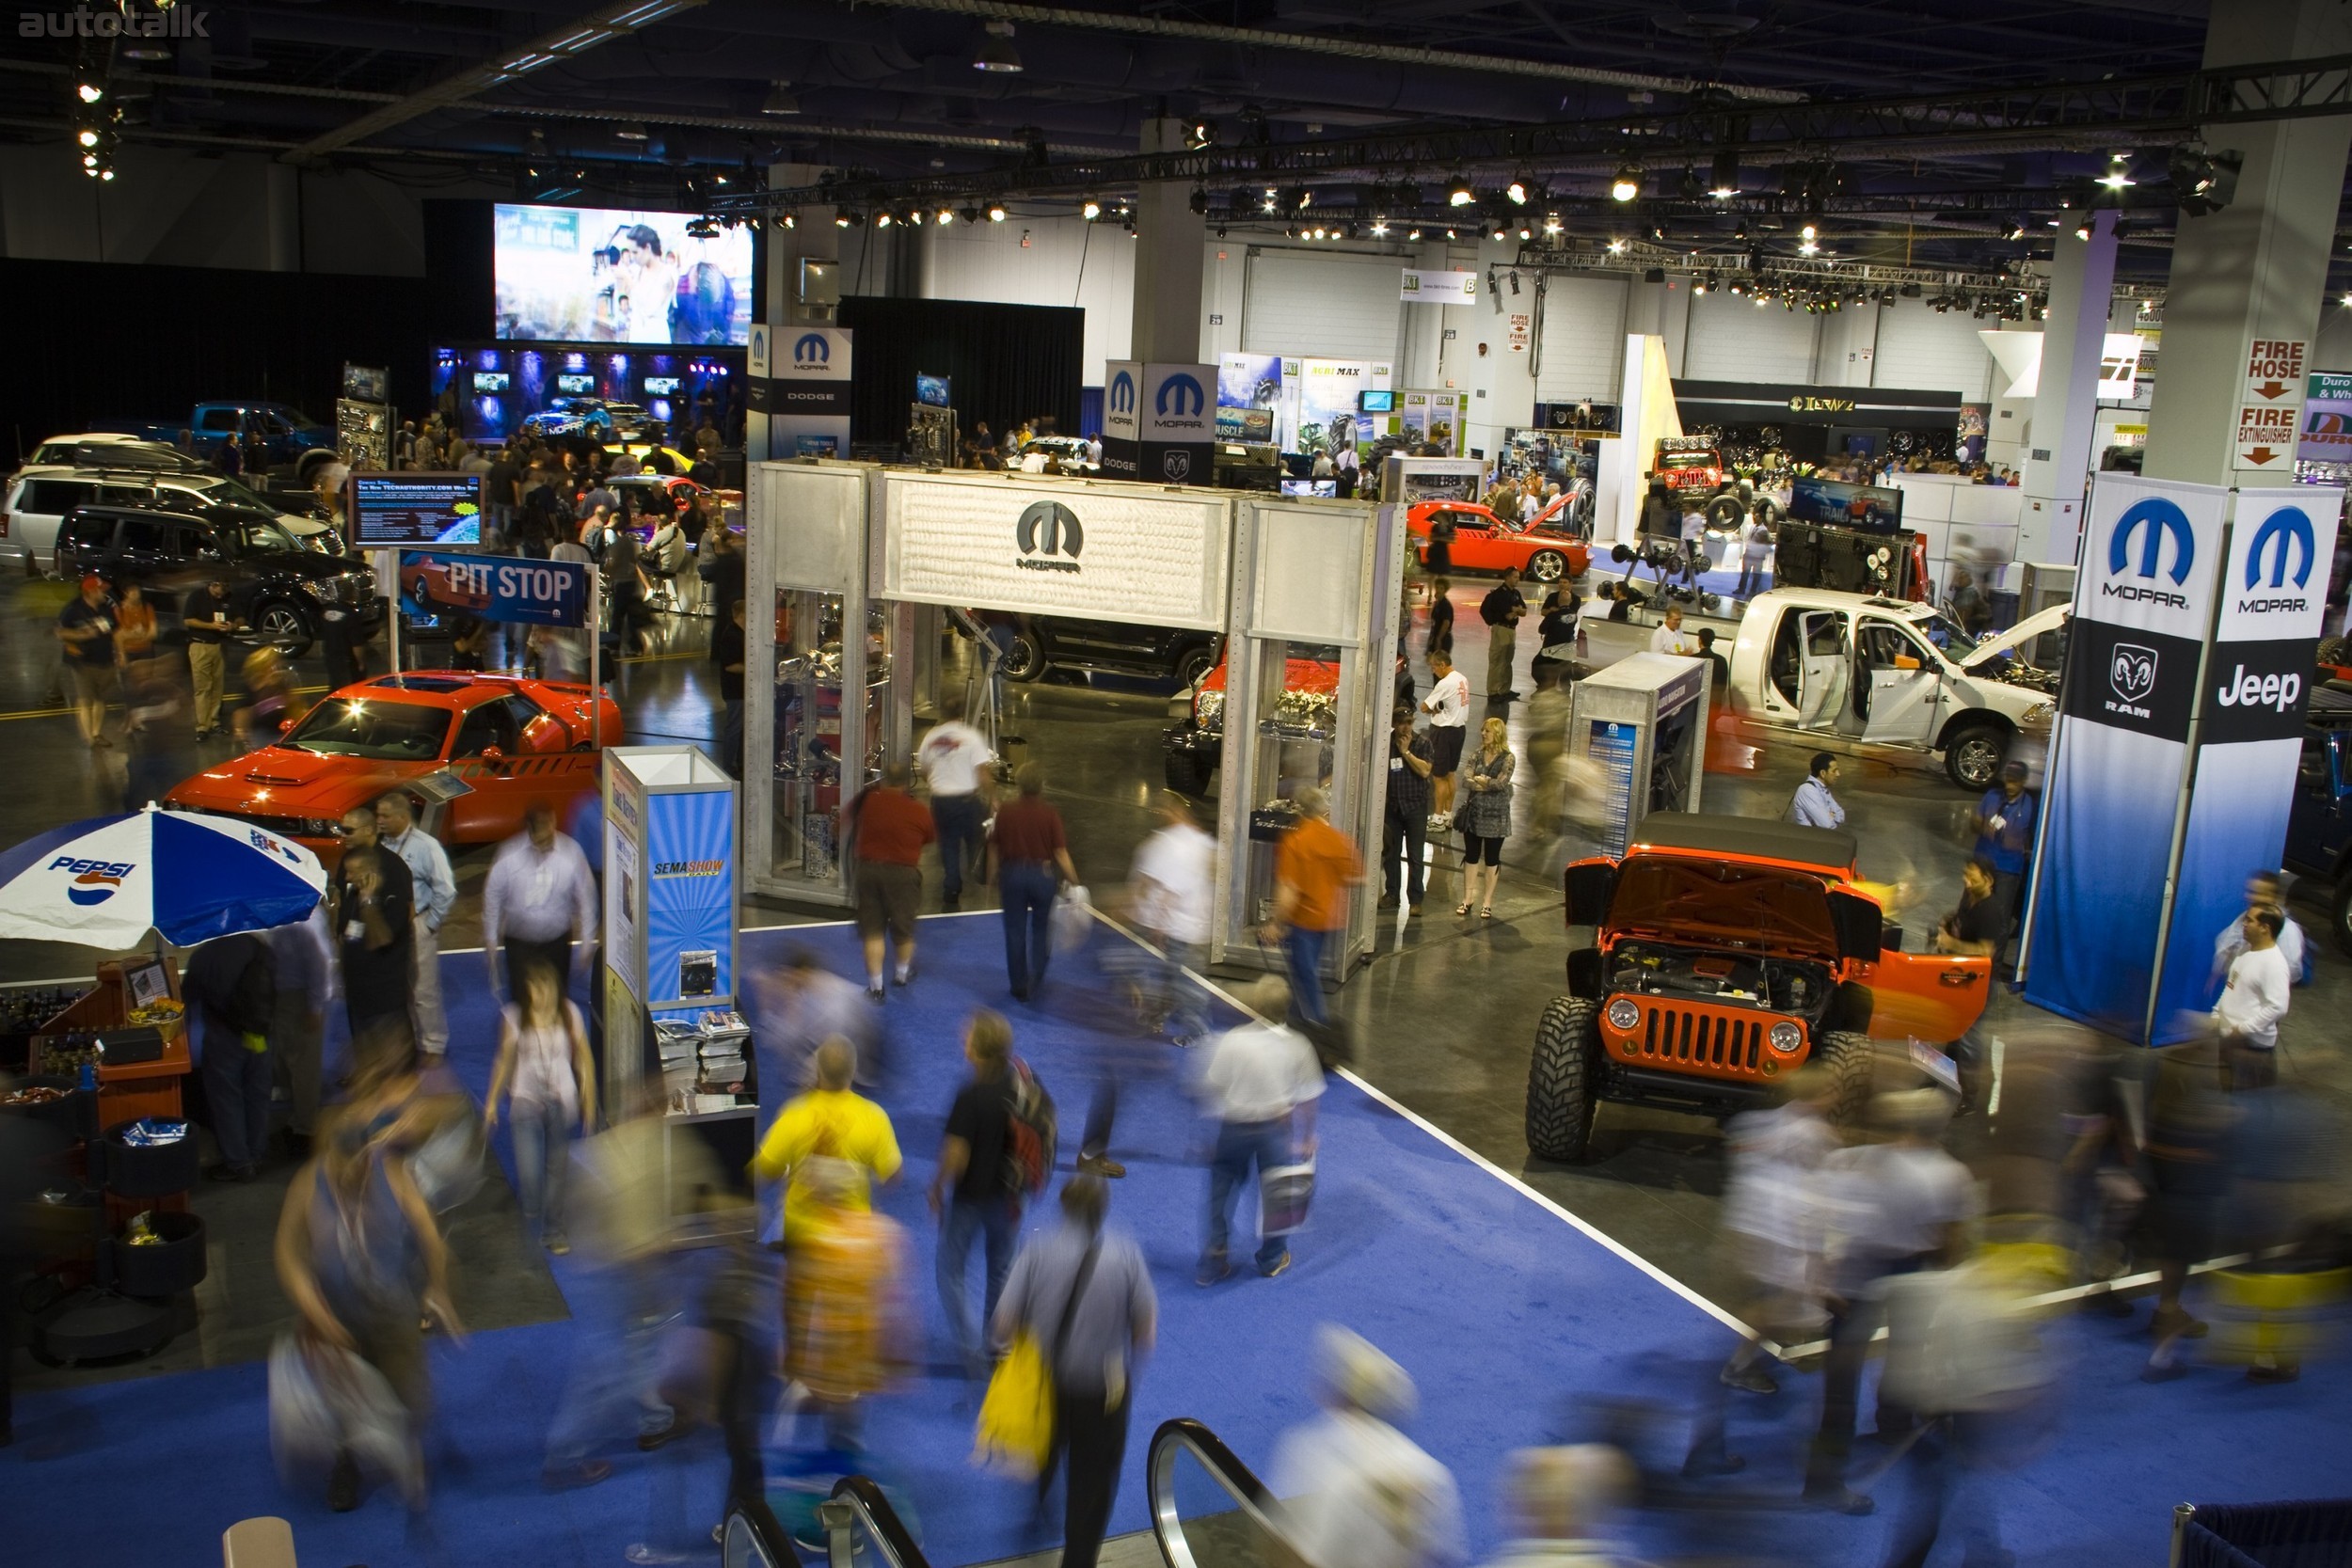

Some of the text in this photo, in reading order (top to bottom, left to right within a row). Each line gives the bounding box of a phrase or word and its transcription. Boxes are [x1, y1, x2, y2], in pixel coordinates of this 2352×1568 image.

[2250, 341, 2305, 359] FIRE
[1283, 362, 1297, 375] BKT
[1311, 367, 1359, 376] AGRI MAX
[2249, 359, 2302, 378] HOSE
[787, 392, 834, 401] DODGE
[1408, 395, 1425, 404] BKT
[1437, 396, 1454, 405] BKT
[2319, 388, 2328, 399] &
[1108, 415, 1134, 427] MOPAR
[1154, 420, 1202, 429] MOPAR
[2241, 408, 2296, 427] FIRE
[548, 420, 584, 436] MOPAR
[2238, 427, 2293, 444] EXTINGUISHER
[1104, 457, 1136, 471] DODGE
[1016, 558, 1081, 574] MOPAR
[450, 562, 573, 602] PIT STOP
[2103, 582, 2185, 610] MOPAR
[2238, 598, 2306, 613] MOPAR
[2218, 664, 2301, 713] Jeep
[2105, 700, 2151, 719] RAM
[48, 856, 136, 879] PEPSI
